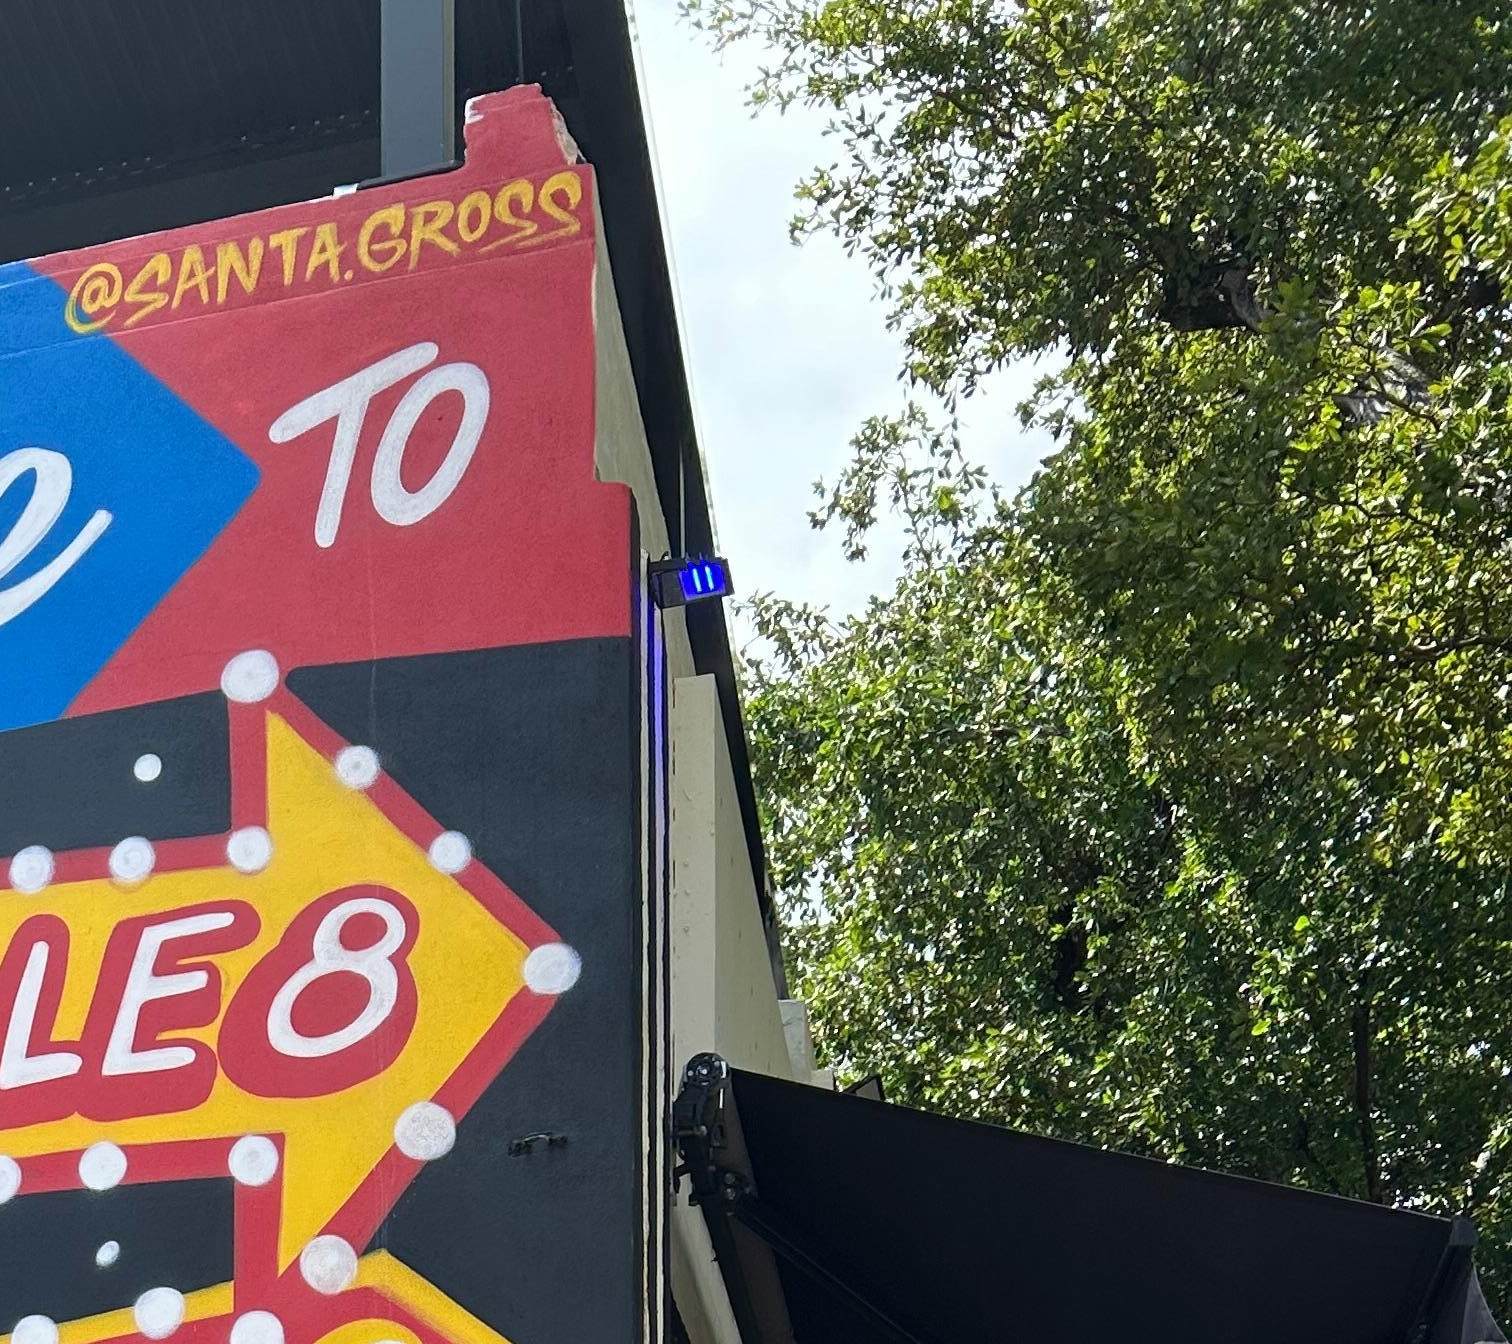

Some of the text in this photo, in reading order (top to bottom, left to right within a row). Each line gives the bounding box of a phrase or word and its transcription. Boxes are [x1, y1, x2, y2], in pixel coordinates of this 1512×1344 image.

[64, 171, 582, 334] @SANTA.GROSS
[268, 341, 491, 548] TO
[265, 896, 407, 1059] 8
